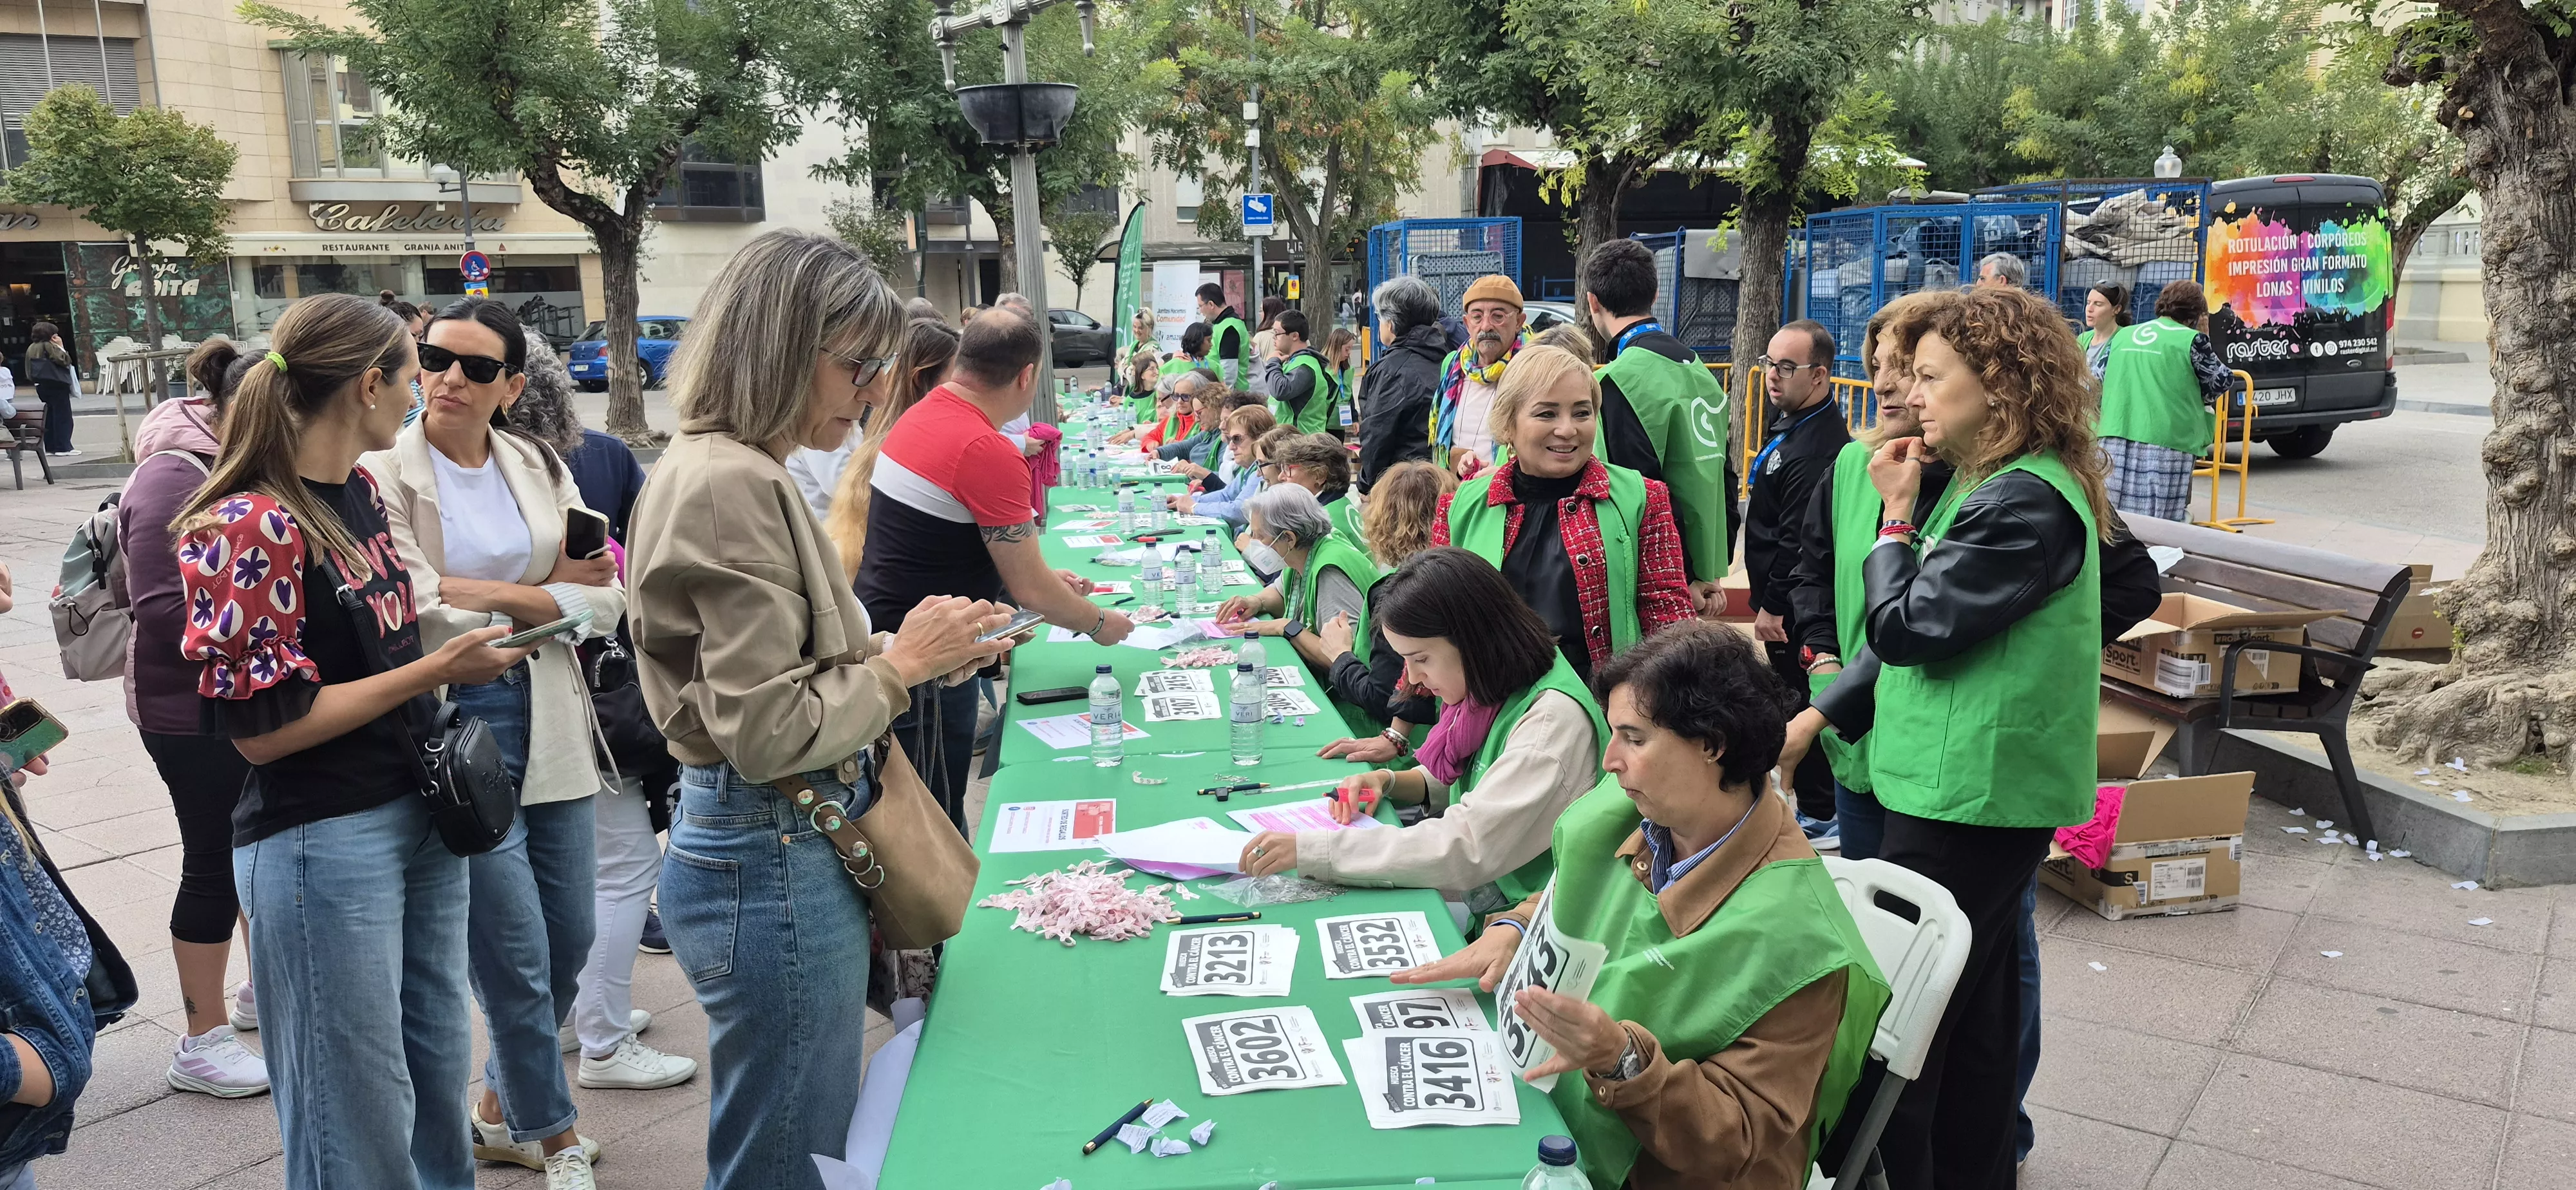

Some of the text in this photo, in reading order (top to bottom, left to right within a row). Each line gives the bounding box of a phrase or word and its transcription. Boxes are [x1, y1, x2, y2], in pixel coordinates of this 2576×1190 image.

[322, 243, 390, 252] RESTAURANTE
[444, 243, 465, 251] ANIT
[2228, 230, 2367, 254] ROTULACIÓN CORPÓREOS
[111, 255, 179, 290] Grnja
[2228, 254, 2367, 276] IMPRESIÓN GRAN FORMATO
[2256, 278, 2344, 298] LONAS VINILOS
[1156, 314, 1186, 323] Comunidad
[2226, 337, 2289, 359] raster
[2338, 337, 2378, 348] 974 230 542
[2245, 389, 2293, 402] 420 JHX
[329, 531, 406, 591] LVE
[365, 579, 417, 639] YOU
[1170, 697, 1200, 715] 3107
[2124, 873, 2134, 885] S
[1188, 937, 1202, 956] CÁNCER
[1339, 924, 1361, 969] CONTRA EL CÁNCER
[1356, 921, 1410, 967] 3532
[1204, 934, 1248, 983] 3213
[1186, 963, 1198, 983] CONTRA
[1503, 923, 1557, 1059] 343
[1209, 1025, 1227, 1050] CÁNCER
[1206, 1045, 1220, 1064] HUESCA
[1219, 1048, 1231, 1058] EL
[1229, 1018, 1298, 1081] 3602
[1222, 1056, 1242, 1083] CONTRA
[1390, 1066, 1399, 1084] HUESCA
[1397, 1042, 1416, 1107] CONTRA EL CÁNCER
[1419, 1041, 1475, 1108] 3416
